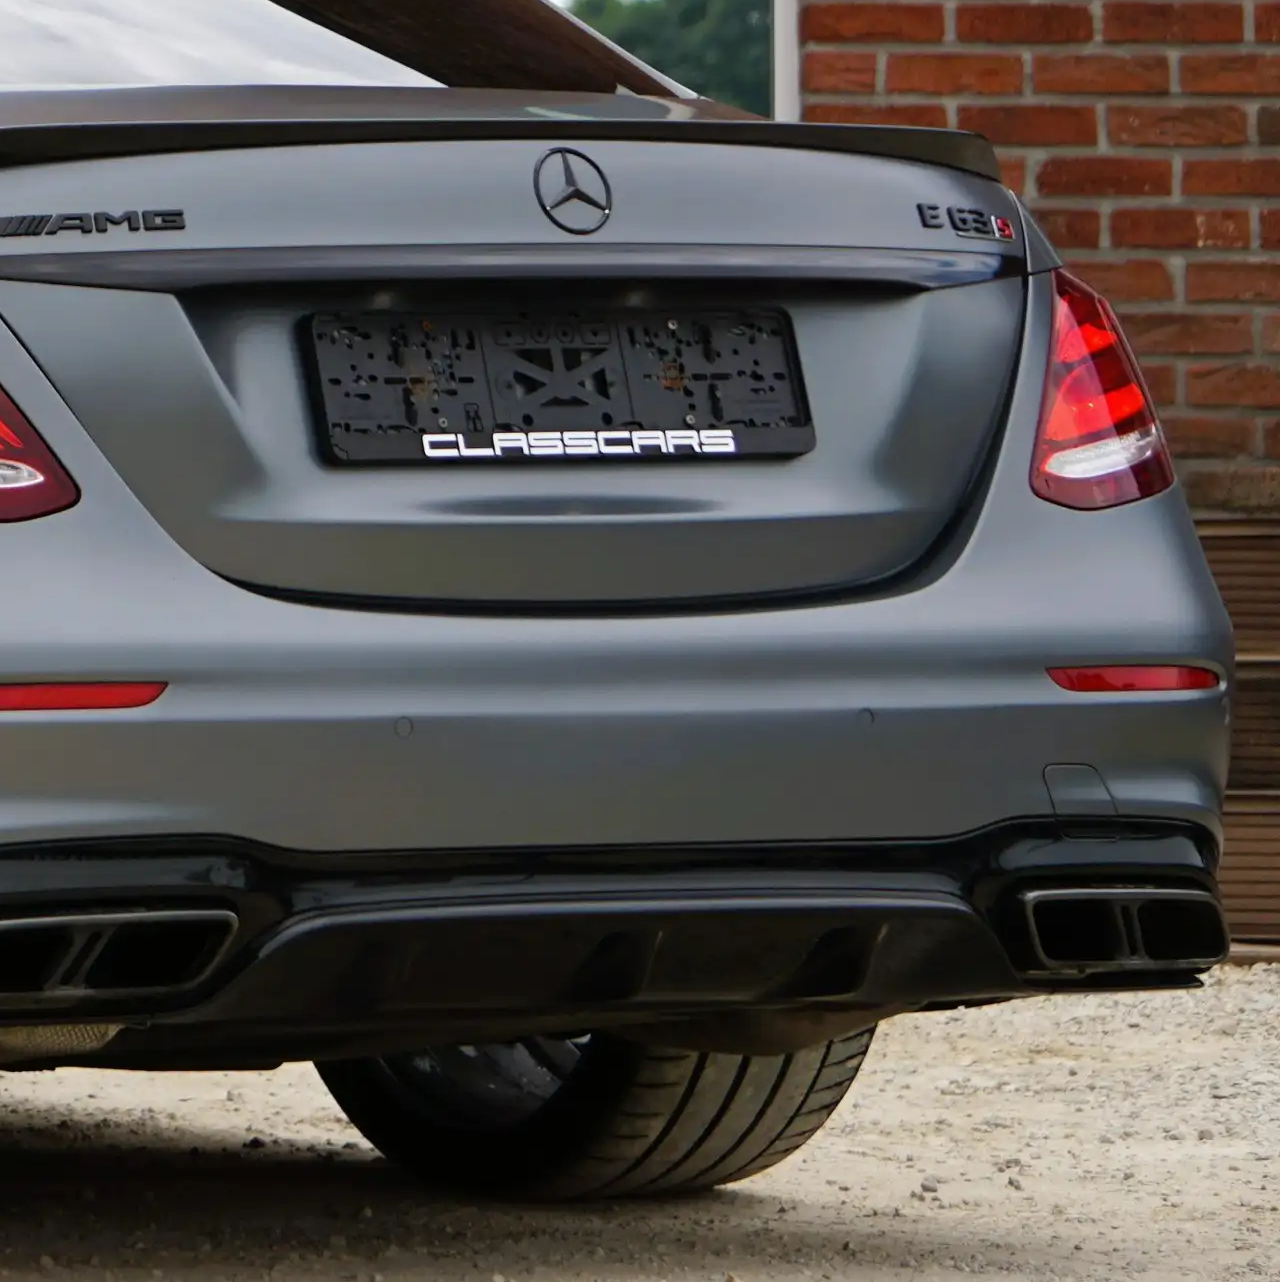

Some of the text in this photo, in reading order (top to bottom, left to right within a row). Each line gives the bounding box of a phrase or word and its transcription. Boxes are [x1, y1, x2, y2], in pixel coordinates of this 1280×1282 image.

[44, 208, 187, 236] AMG
[916, 202, 945, 229] E
[422, 429, 737, 459] CLASSCARS
